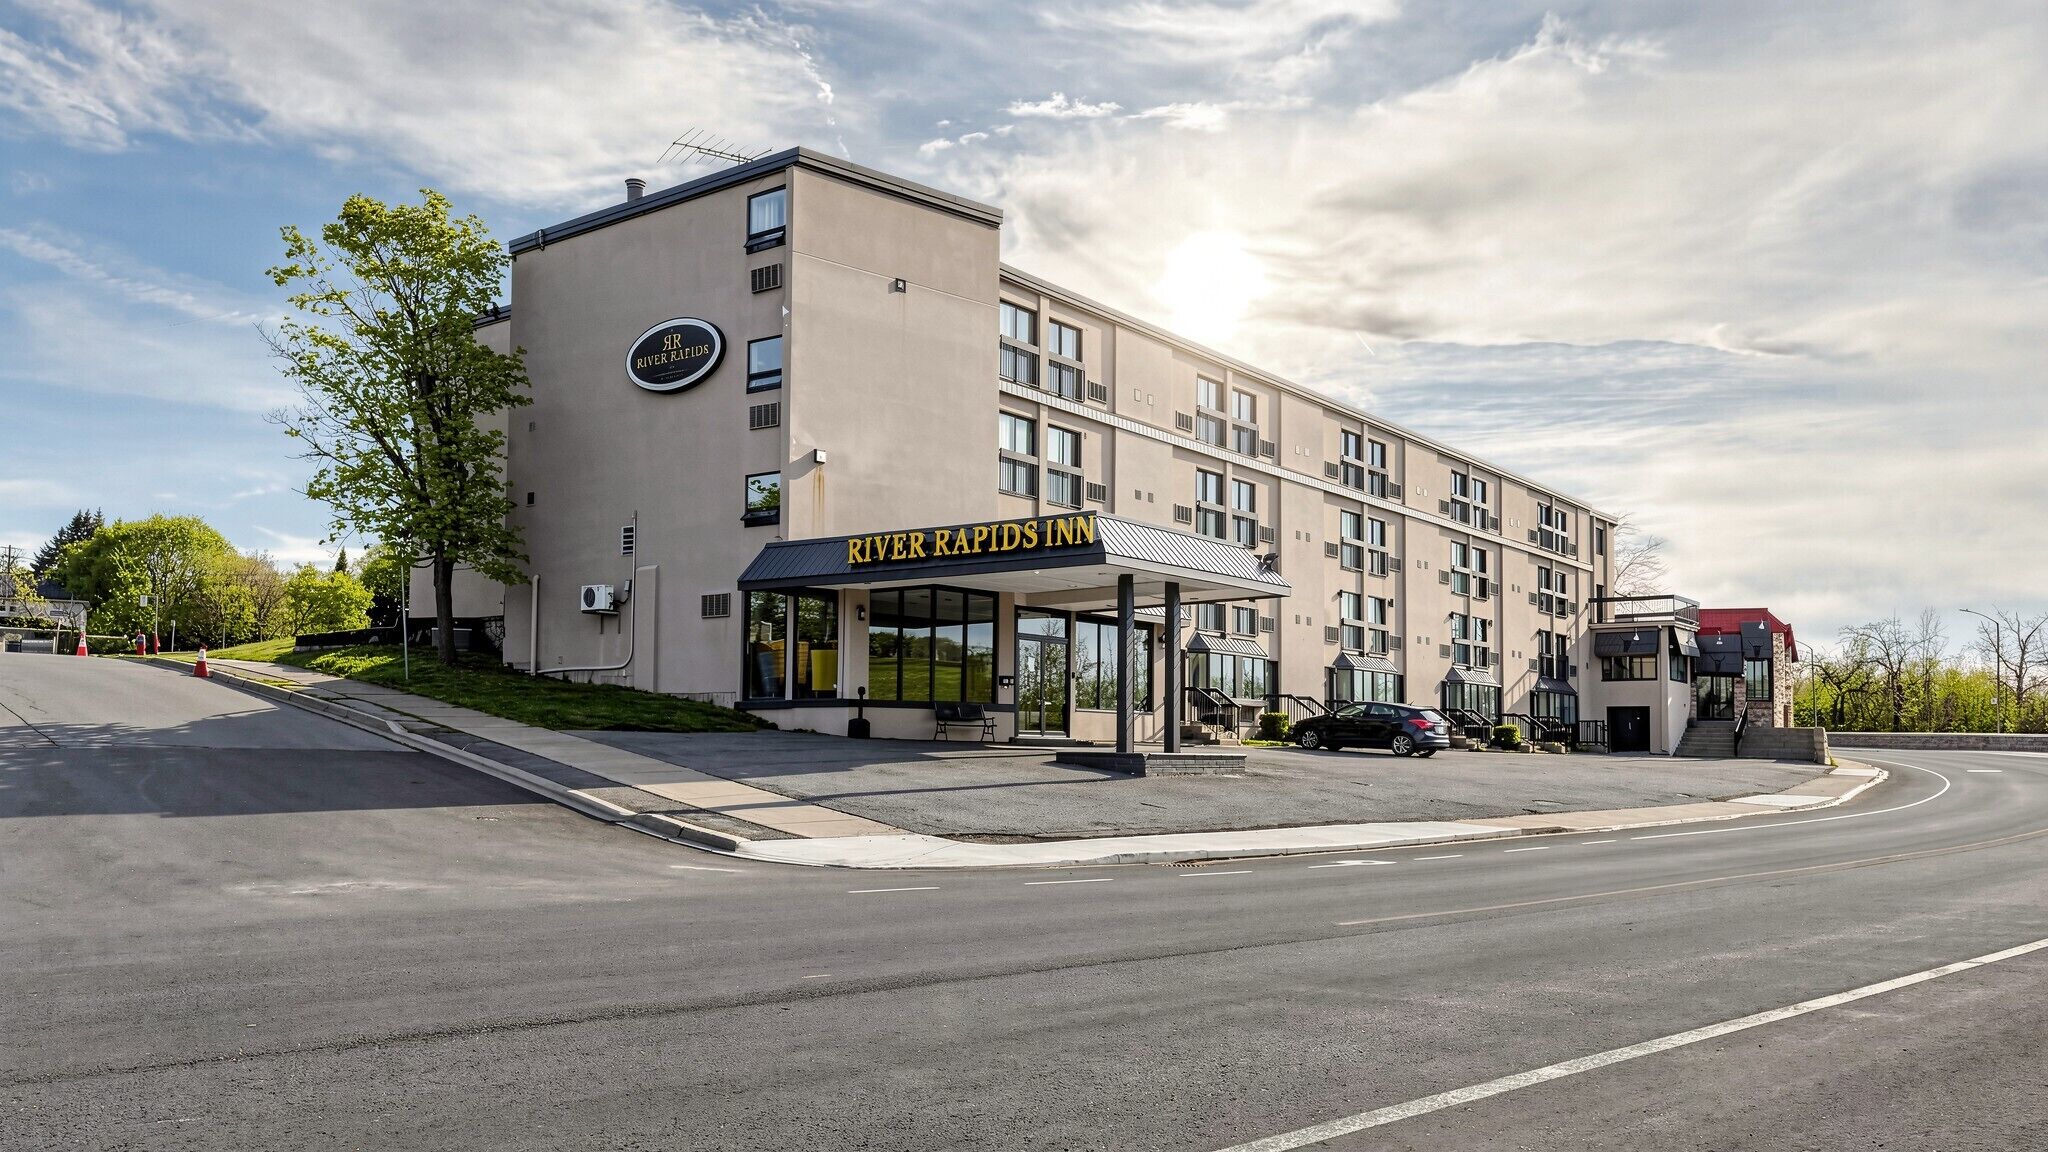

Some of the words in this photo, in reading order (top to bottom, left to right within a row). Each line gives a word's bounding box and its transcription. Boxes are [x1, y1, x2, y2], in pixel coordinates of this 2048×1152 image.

[637, 353, 668, 369] RIVER
[670, 344, 709, 362] RAPIDS
[847, 532, 927, 564] RIVER
[933, 520, 1039, 556] RAPIDS
[1044, 515, 1098, 547] INN
